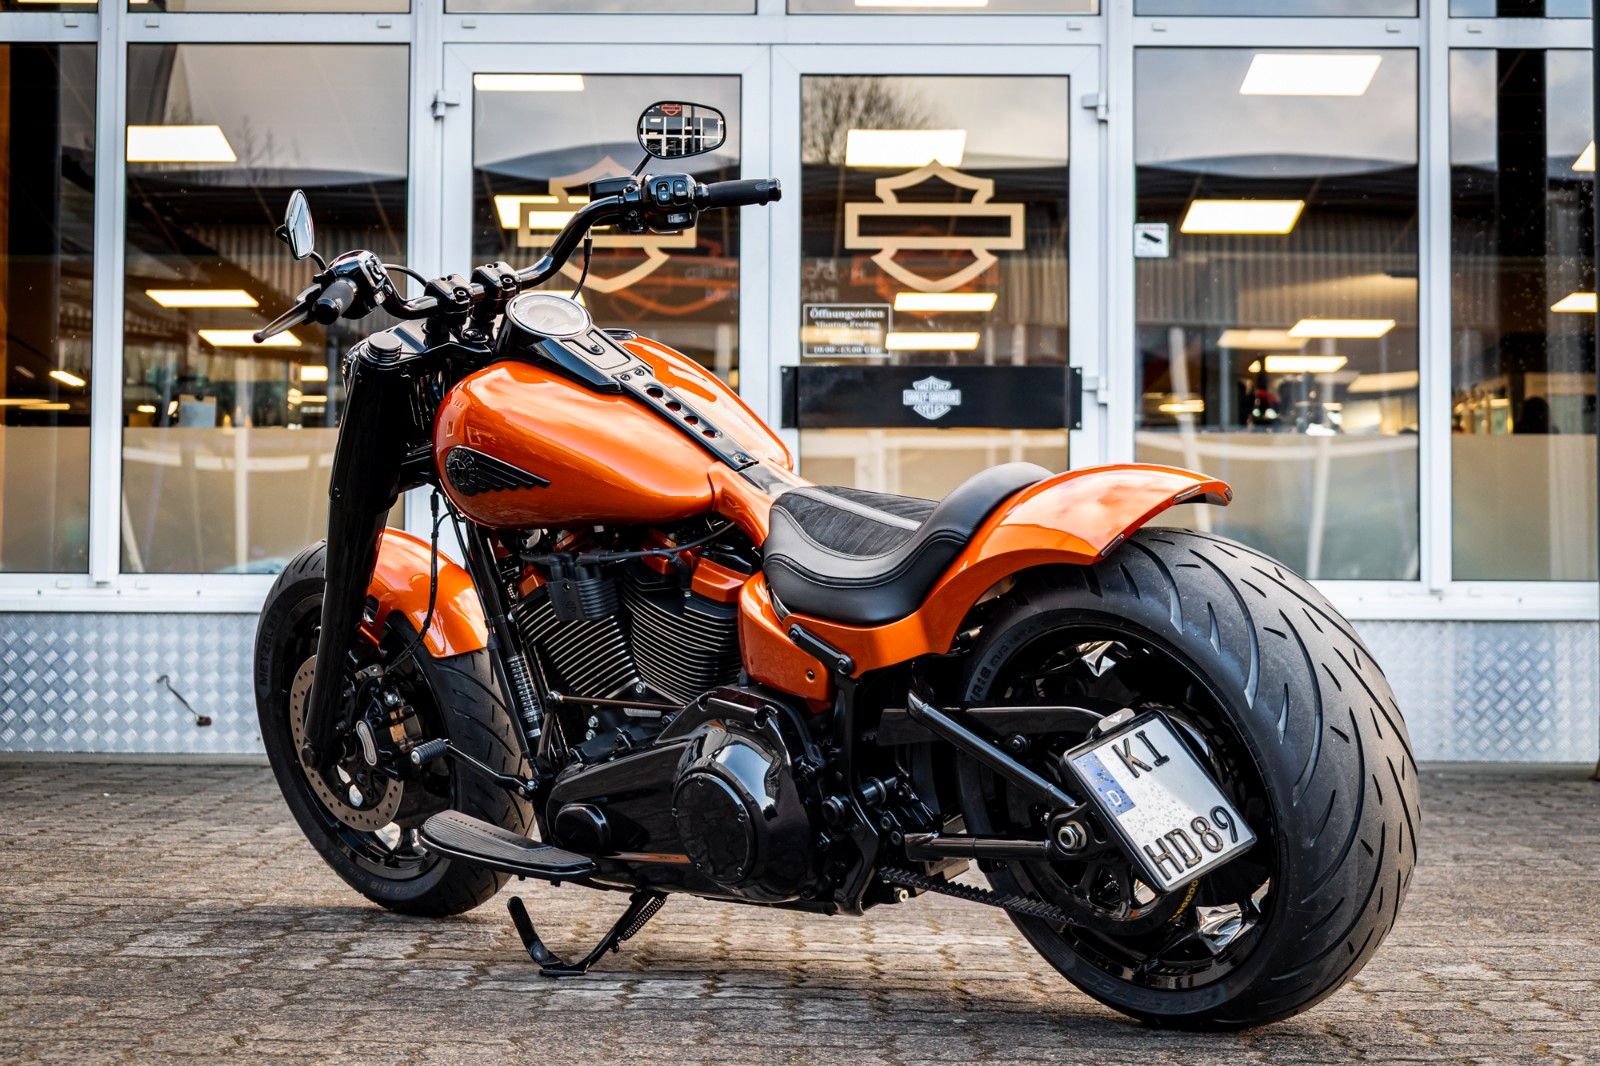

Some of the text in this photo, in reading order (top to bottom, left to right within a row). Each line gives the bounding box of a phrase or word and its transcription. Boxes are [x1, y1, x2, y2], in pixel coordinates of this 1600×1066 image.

[809, 307, 885, 320] Öffnungszeiten
[1111, 729, 1170, 778] KI
[1106, 790, 1122, 806] D
